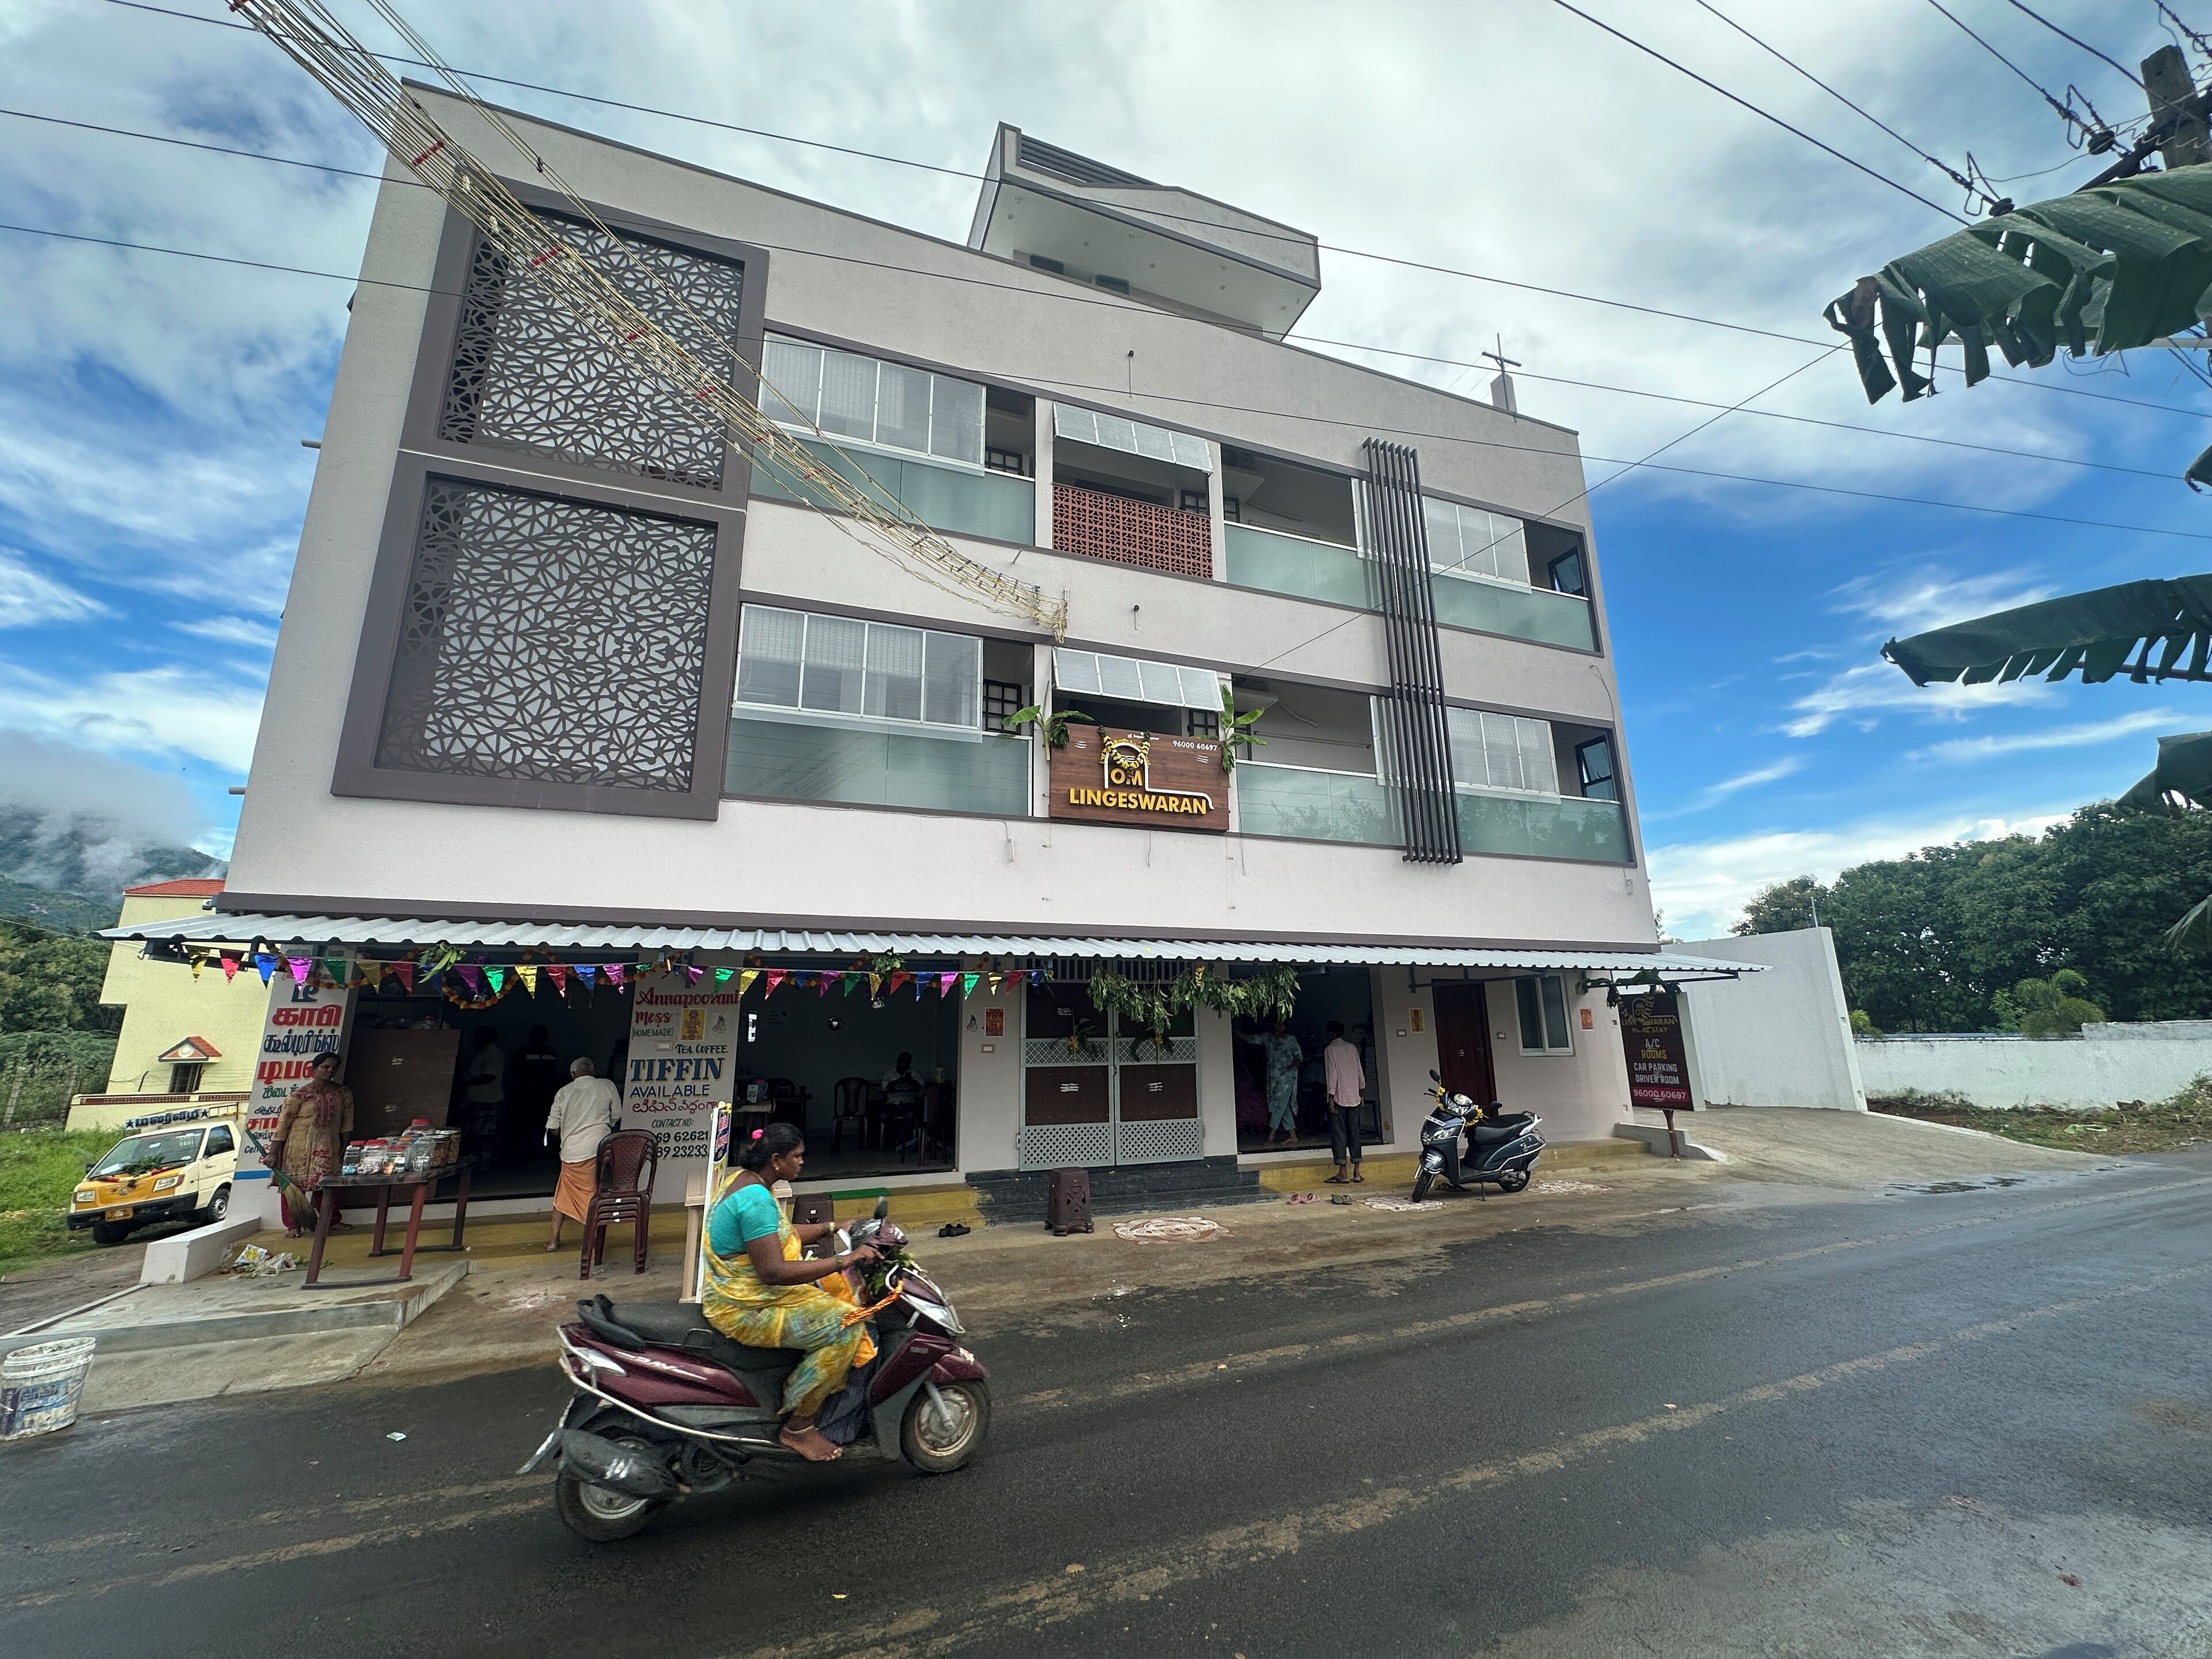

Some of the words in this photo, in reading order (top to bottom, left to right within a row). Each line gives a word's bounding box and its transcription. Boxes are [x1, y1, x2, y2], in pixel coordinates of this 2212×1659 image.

[1172, 740, 1195, 749] 96000
[1196, 743, 1218, 751] 60697
[1111, 768, 1143, 786] OM
[1070, 787, 1207, 815] LINGESWARAN
[272, 1004, 342, 1027] காபி
[264, 1028, 340, 1055] கூல்டிரிங்ஸ்
[1645, 1039, 1660, 1048] A/C
[1641, 1050, 1667, 1059] ROOMS
[630, 1058, 725, 1082] TIFFIN
[1634, 1062, 1647, 1071] CAR
[1648, 1063, 1678, 1072] PARKING
[1635, 1074, 1658, 1083] DRIVER
[1660, 1075, 1680, 1084] ROOM
[630, 1085, 710, 1097] AVAILABLE
[1633, 1089, 1659, 1097] 96000
[1660, 1090, 1685, 1099] 60697
[135, 1110, 199, 1128] மலர்விழி
